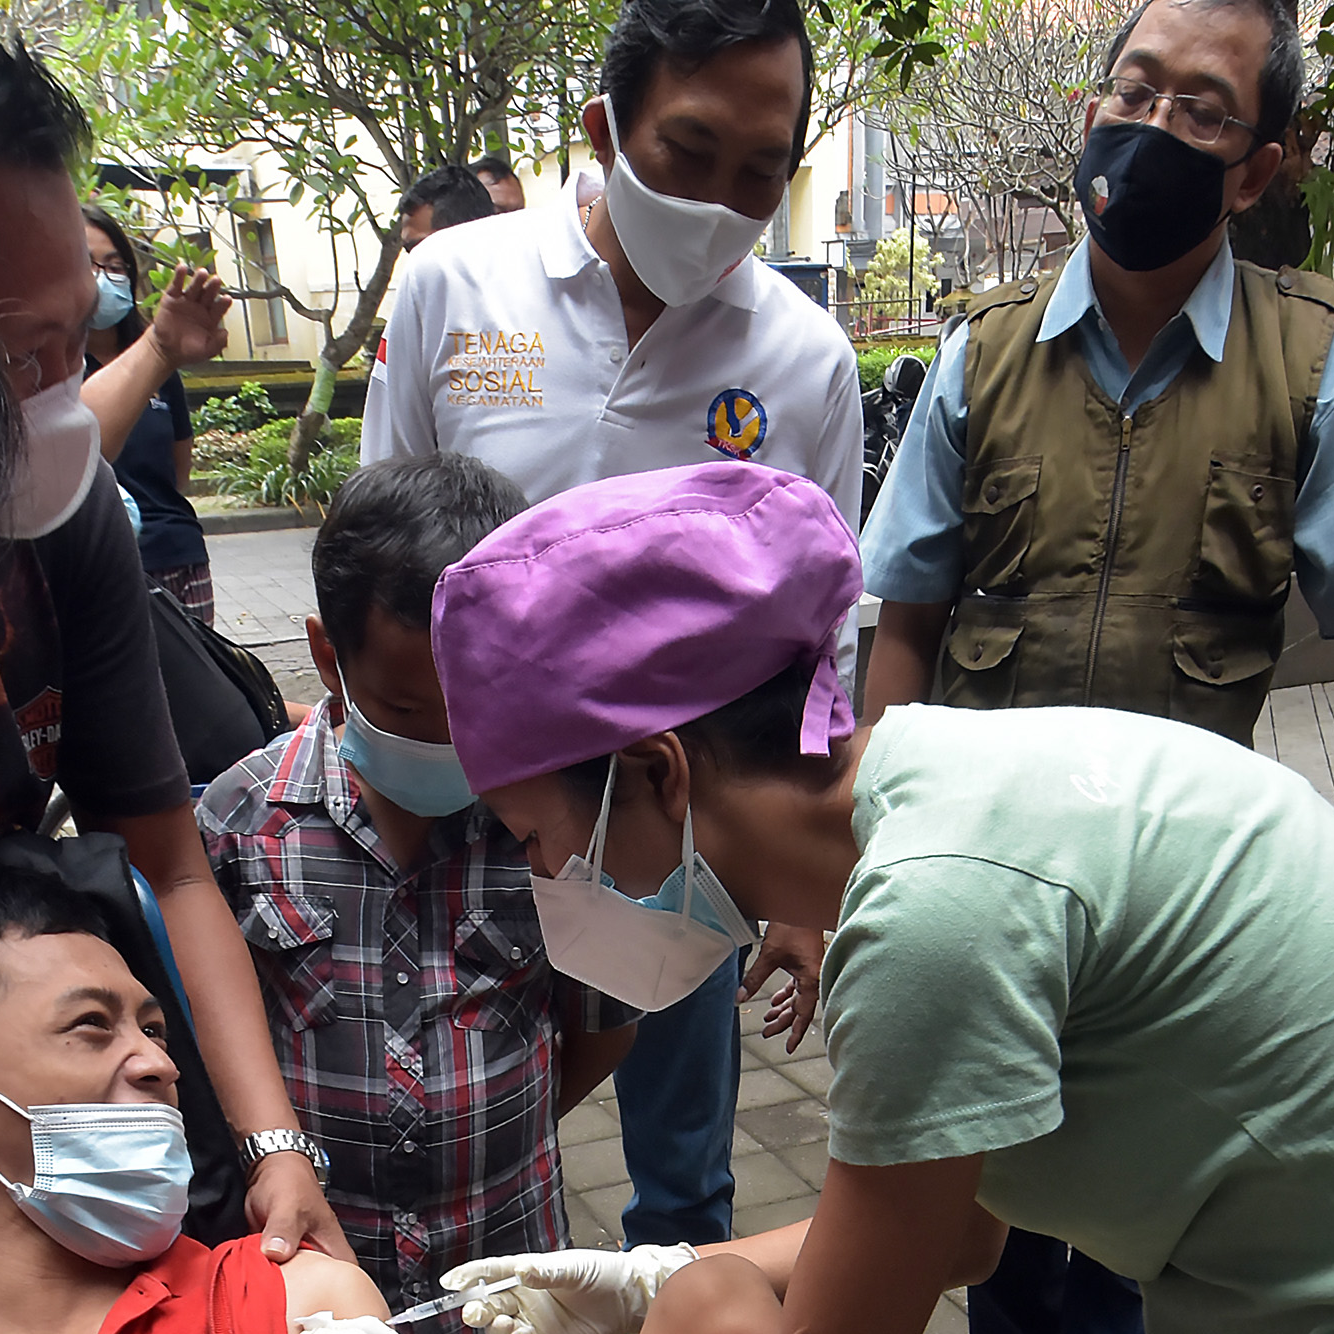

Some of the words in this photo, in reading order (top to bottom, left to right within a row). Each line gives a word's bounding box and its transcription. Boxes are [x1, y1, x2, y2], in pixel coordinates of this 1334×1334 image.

[447, 330, 545, 355] TENAGA
[448, 355, 545, 368] KESEJAHTERAAN
[449, 369, 543, 393] SOSIAL
[447, 393, 544, 407] KECAMATAN
